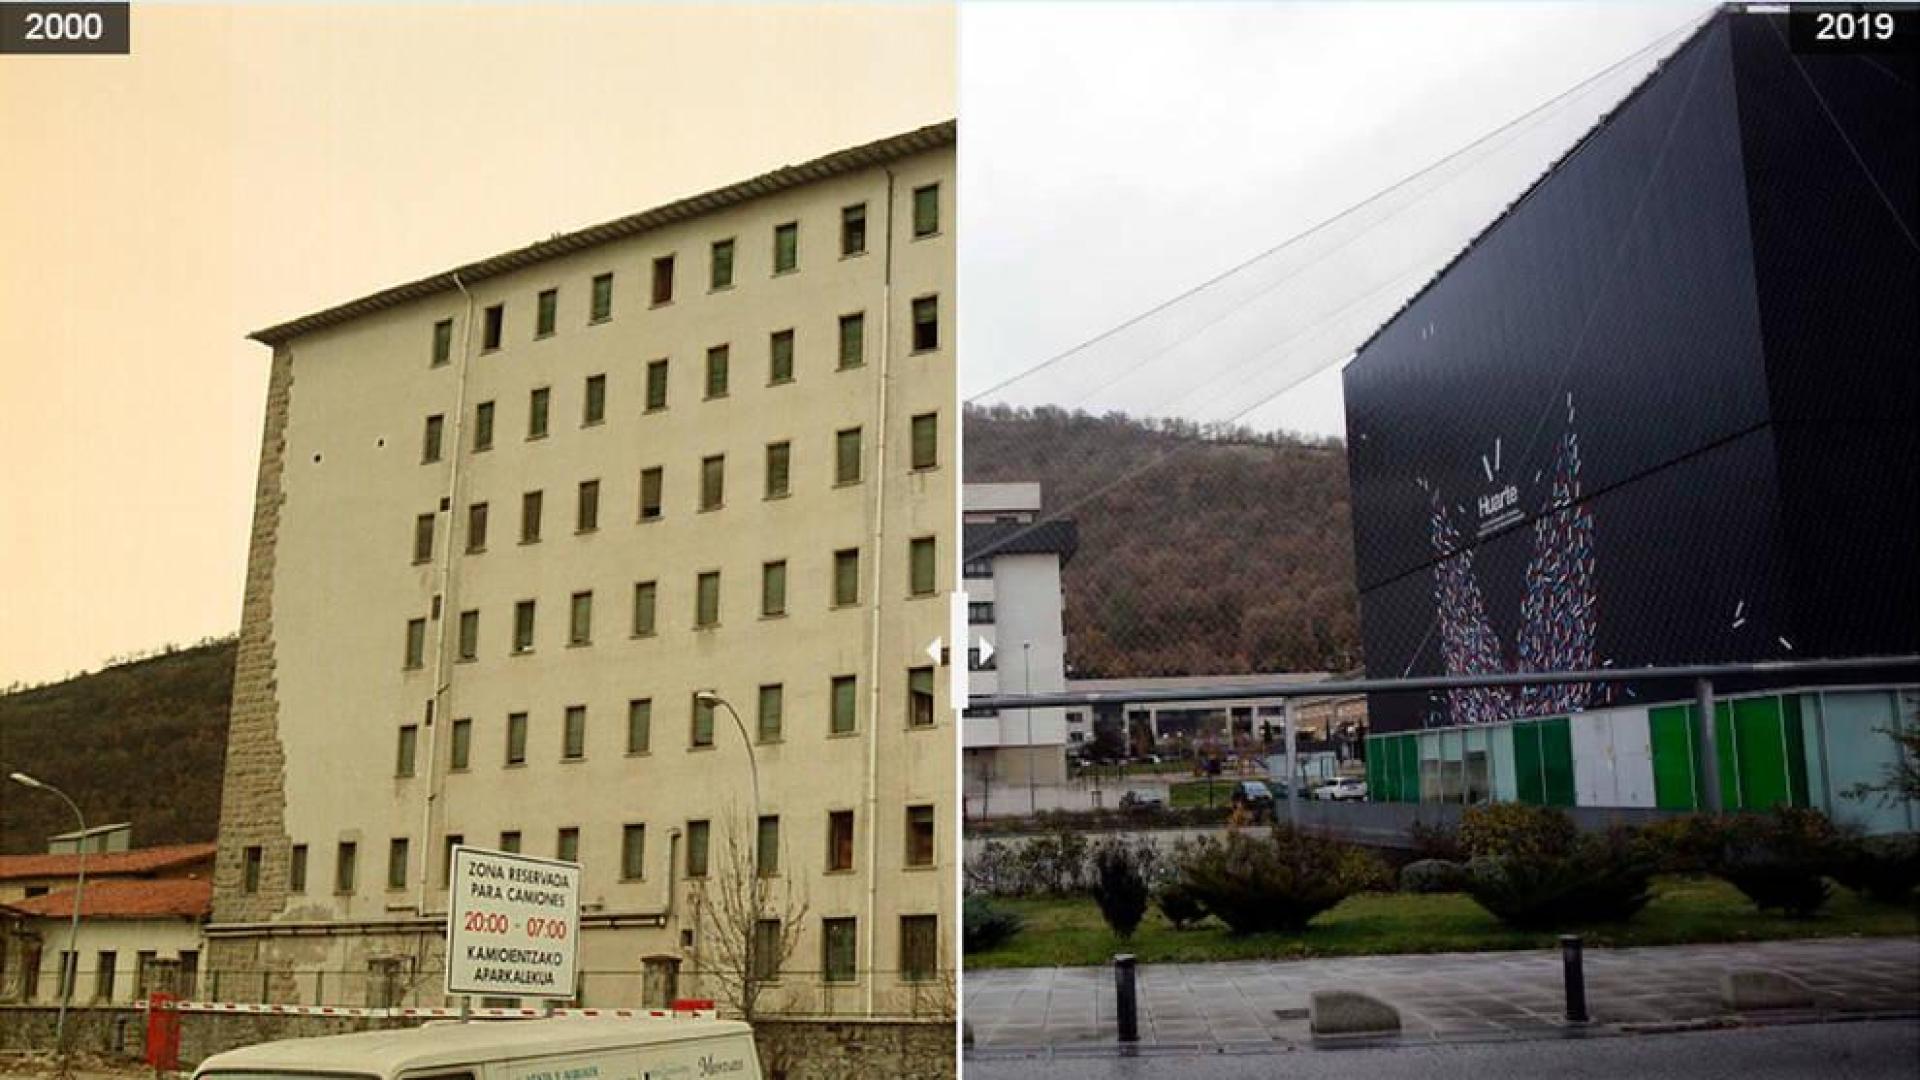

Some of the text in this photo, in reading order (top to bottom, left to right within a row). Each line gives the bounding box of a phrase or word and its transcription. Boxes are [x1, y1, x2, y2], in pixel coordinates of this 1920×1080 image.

[1478, 485, 1519, 518] Huarte
[468, 861, 570, 888] ZONA RESERVADA
[471, 883, 565, 907] PARA CAMIONES
[464, 911, 508, 934] 20:00
[527, 917, 567, 939] 07:00
[467, 946, 563, 966] KAMIOENTZAKO
[473, 967, 554, 986] APARKALEKUA
